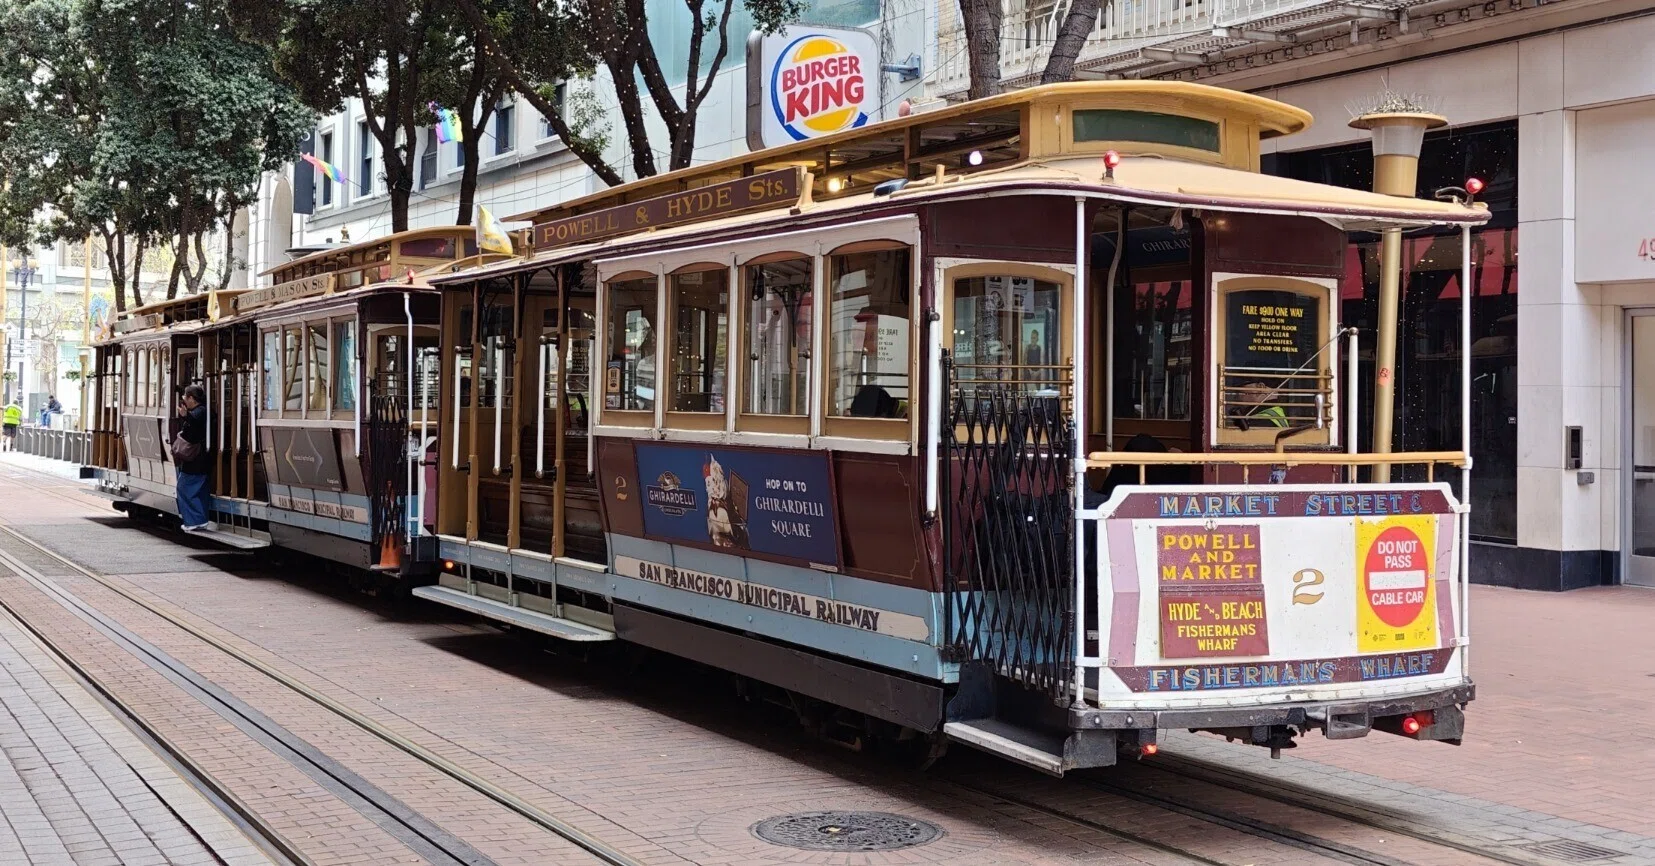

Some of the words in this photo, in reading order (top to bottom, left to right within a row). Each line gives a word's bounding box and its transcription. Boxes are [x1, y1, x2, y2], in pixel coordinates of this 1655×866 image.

[782, 55, 860, 92] BURGER
[786, 75, 864, 123] KING
[543, 214, 619, 243] POWELL
[635, 206, 649, 223] &
[667, 187, 732, 218] HYDE
[749, 178, 788, 201] Sts.
[279, 281, 308, 298] MASON
[1242, 305, 1258, 315] FARE
[1275, 307, 1289, 317] ONE
[1290, 308, 1304, 318] WAY
[616, 475, 628, 500] 2
[766, 478, 781, 490] HOP
[783, 480, 794, 491] ON
[795, 481, 807, 493] TO
[649, 490, 695, 506] GHIRARDELLI
[755, 496, 824, 517] GHIRARDELLI
[1159, 494, 1280, 518] MARKET
[1306, 494, 1403, 516] STREET
[771, 519, 812, 538] SQUARE
[1164, 533, 1256, 551] POWELL
[1378, 541, 1394, 554] DO
[1396, 540, 1418, 554] NOT
[1189, 550, 1235, 564] AND
[1384, 555, 1412, 569] PASS
[1162, 564, 1258, 581] MARKET
[1292, 568, 1325, 606] 2
[638, 562, 661, 582] SAN
[665, 567, 732, 598] FRANCISCO
[737, 582, 811, 616] MUNICIPAL
[816, 599, 881, 632] RAILWAY
[1372, 592, 1404, 605] CABLE
[1405, 591, 1424, 604] CAR
[1168, 603, 1202, 621] HYDE
[1204, 603, 1221, 620] AND
[1222, 601, 1264, 621] BEACH
[1177, 624, 1256, 637] FISHERMANS
[1197, 638, 1238, 651] WHARF
[1361, 654, 1434, 680] WHARF
